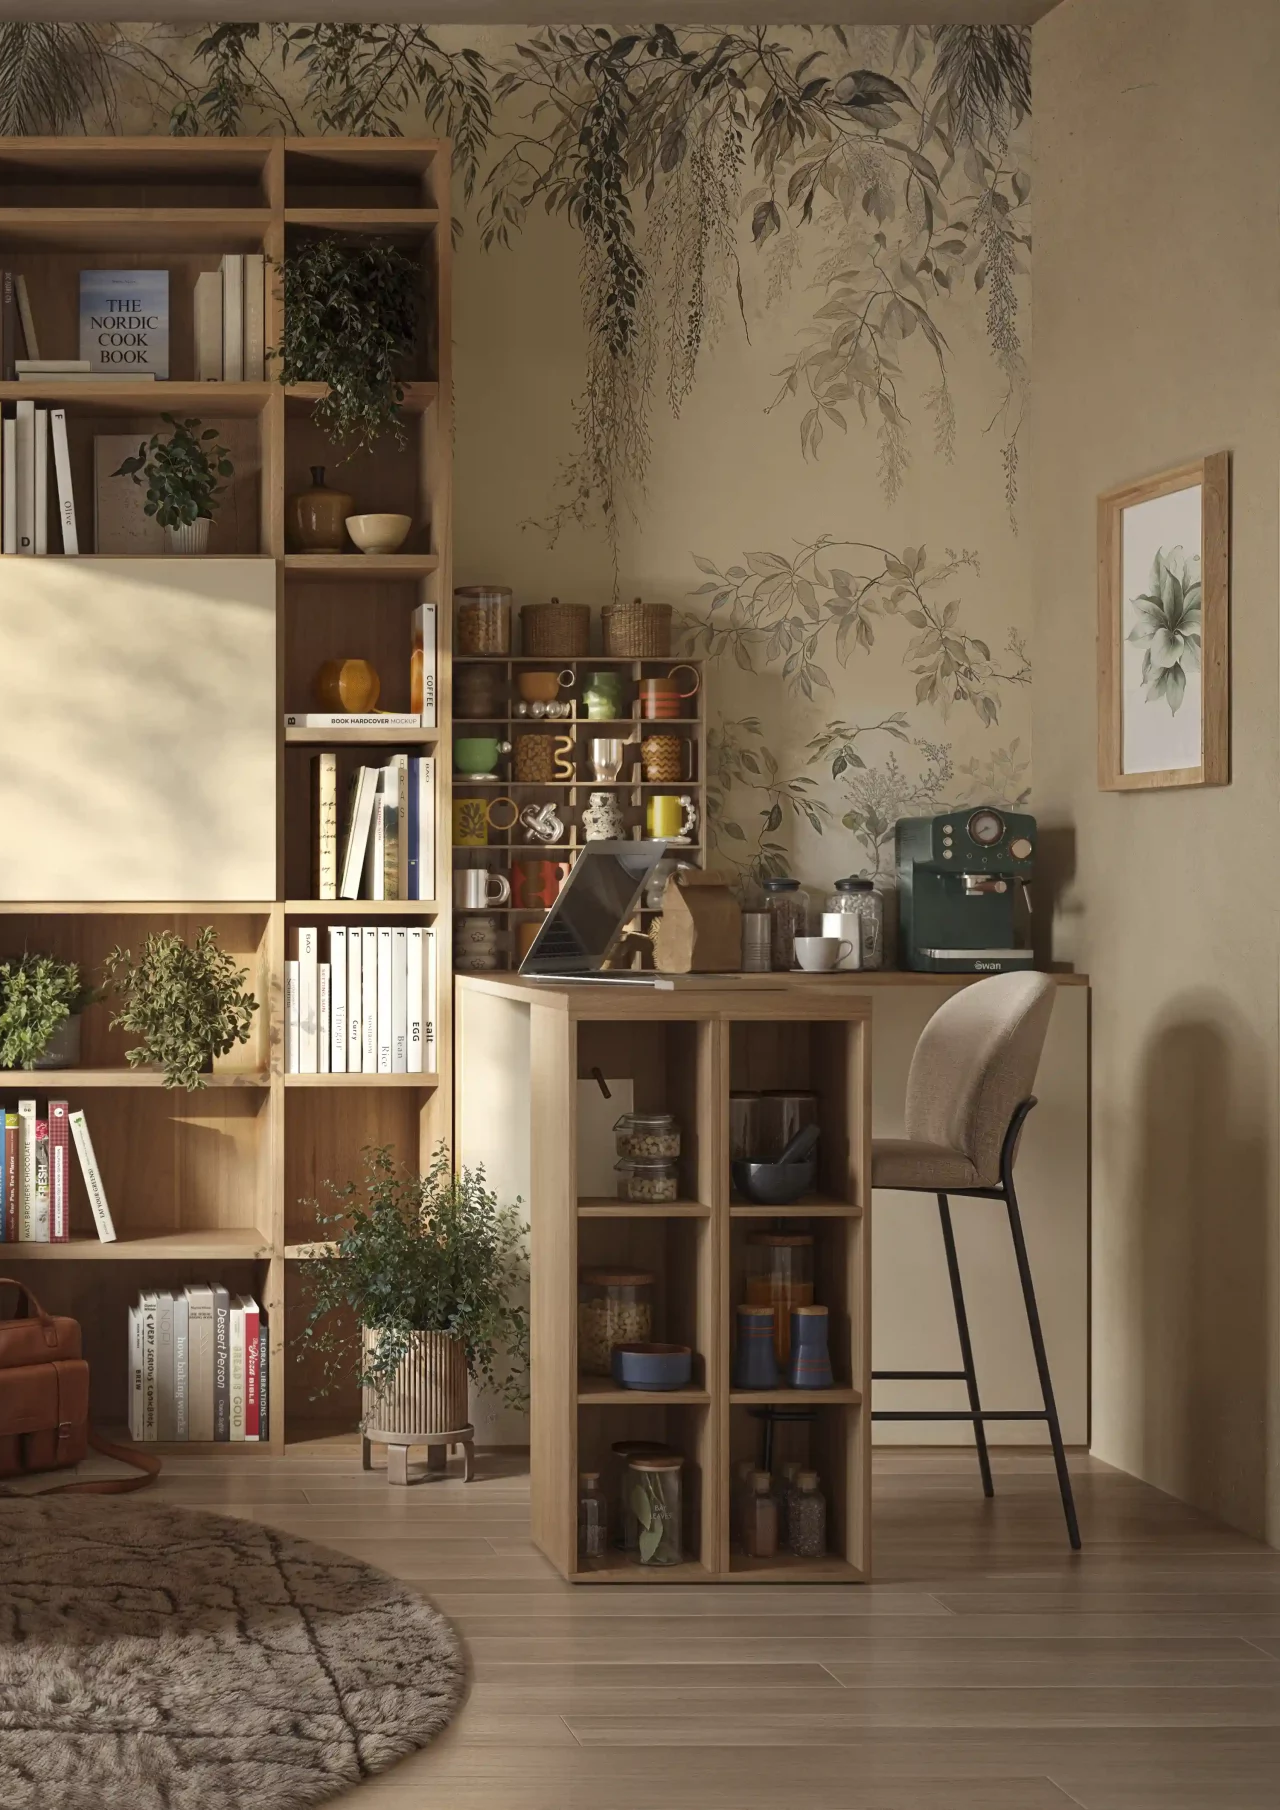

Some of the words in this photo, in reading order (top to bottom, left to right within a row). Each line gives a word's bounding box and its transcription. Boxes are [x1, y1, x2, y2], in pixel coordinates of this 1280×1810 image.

[106, 299, 142, 312] THE
[90, 316, 158, 330] NORDIC
[98, 333, 148, 347] COOK
[100, 350, 148, 364] BOOK
[64, 501, 72, 526] Olive
[21, 537, 30, 548] D
[426, 675, 434, 707] COFFEE
[287, 717, 296, 725] B
[974, 960, 1002, 970] Swan
[336, 1005, 345, 1051] Vinegar
[412, 1022, 420, 1042] EGG
[426, 1022, 434, 1043] salt
[381, 1046, 390, 1067] Rice
[397, 1036, 405, 1059] Bean
[38, 1164, 47, 1197] FRESH
[93, 1192, 102, 1208] YOUR
[97, 1208, 106, 1219] EAT
[146, 1323, 155, 1346] VERY
[160, 1309, 170, 1346] NOPI
[217, 1308, 227, 1350] Dessert
[177, 1337, 186, 1360] how
[146, 1348, 155, 1381] SERIOUS
[217, 1351, 227, 1389] Person
[233, 1345, 242, 1379] BREAD
[249, 1345, 259, 1376] Pizza
[175, 1361, 186, 1399] baking
[177, 1400, 186, 1434] works
[233, 1396, 242, 1427] GOLD
